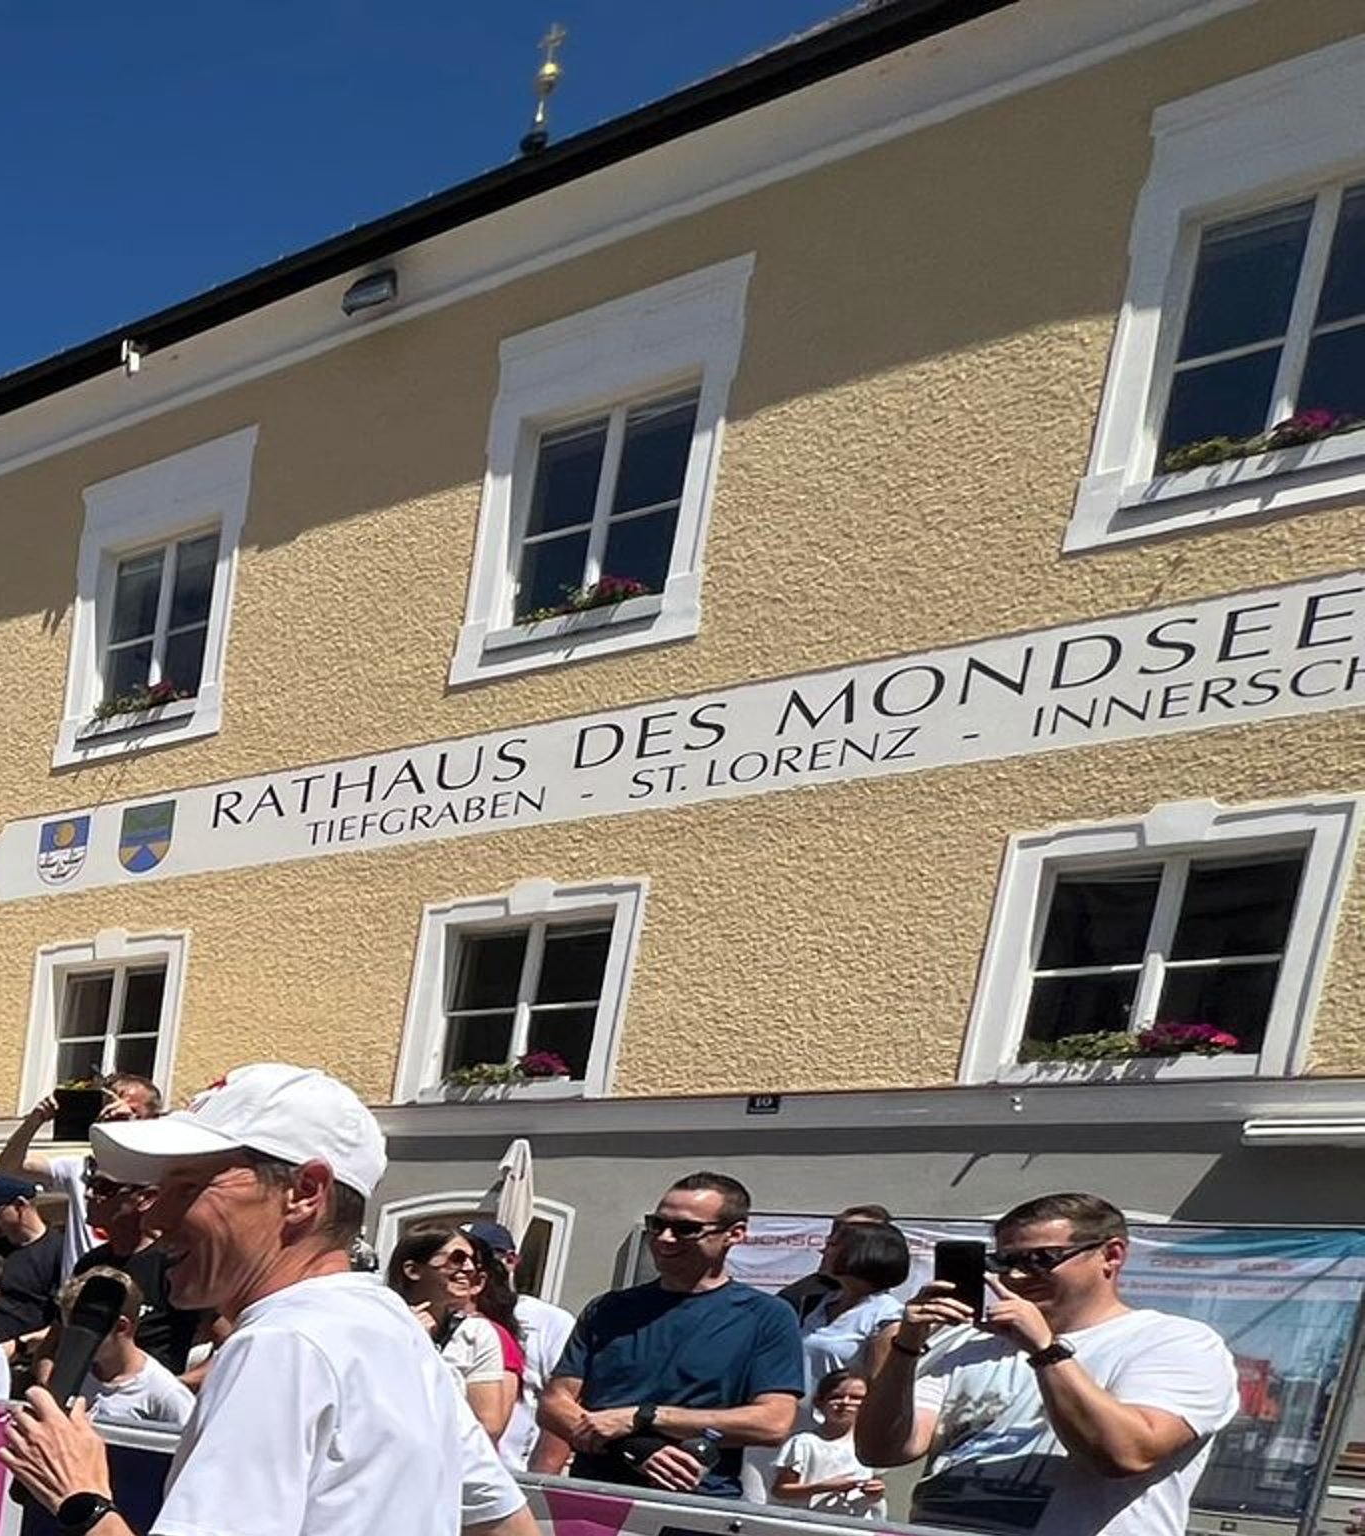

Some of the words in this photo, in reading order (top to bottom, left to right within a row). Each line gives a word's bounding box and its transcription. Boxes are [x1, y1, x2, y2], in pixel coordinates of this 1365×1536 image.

[211, 737, 529, 830] RATHAUS
[572, 702, 726, 770] DES
[775, 587, 1365, 738] MONDSEE
[306, 786, 546, 847] TIEFGRABEN
[628, 763, 688, 800] ST.
[705, 727, 920, 789] LORENZ
